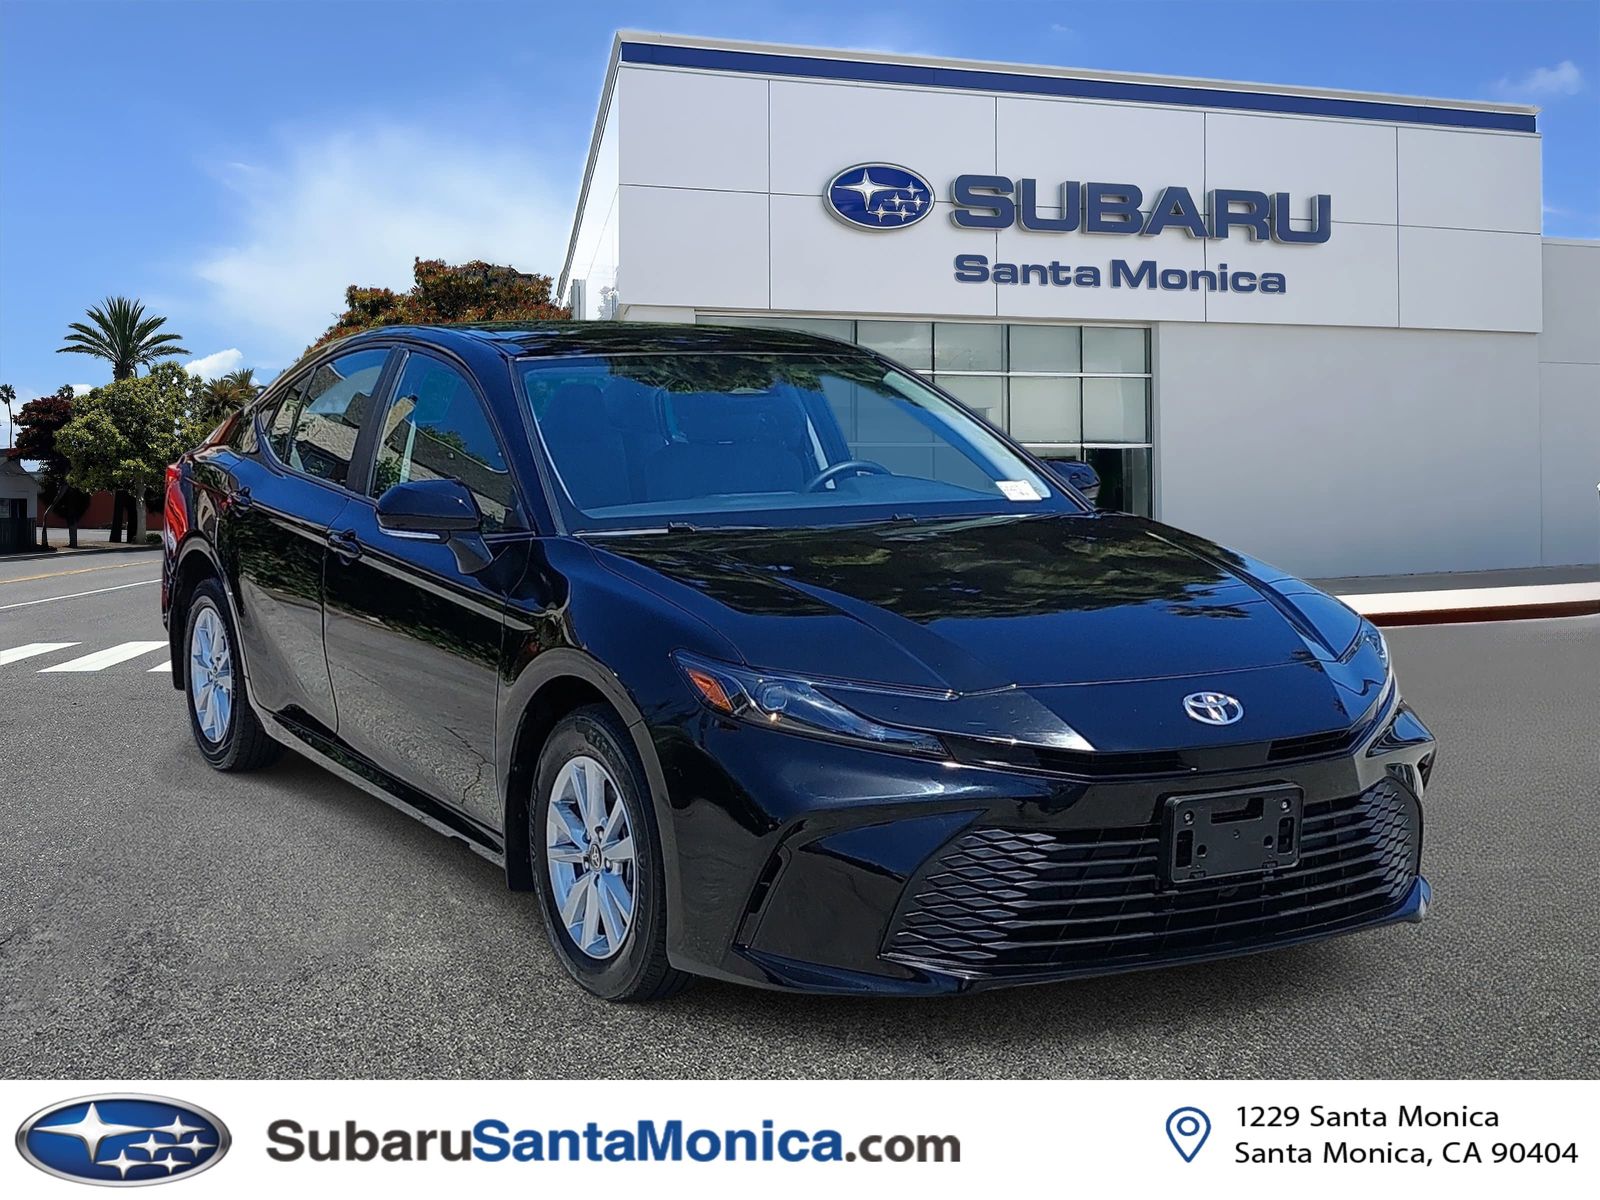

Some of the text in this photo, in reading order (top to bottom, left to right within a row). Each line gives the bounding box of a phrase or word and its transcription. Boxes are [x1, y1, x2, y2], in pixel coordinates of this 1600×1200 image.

[950, 174, 1331, 244] SUBARU
[953, 253, 1287, 294] Santa Monica
